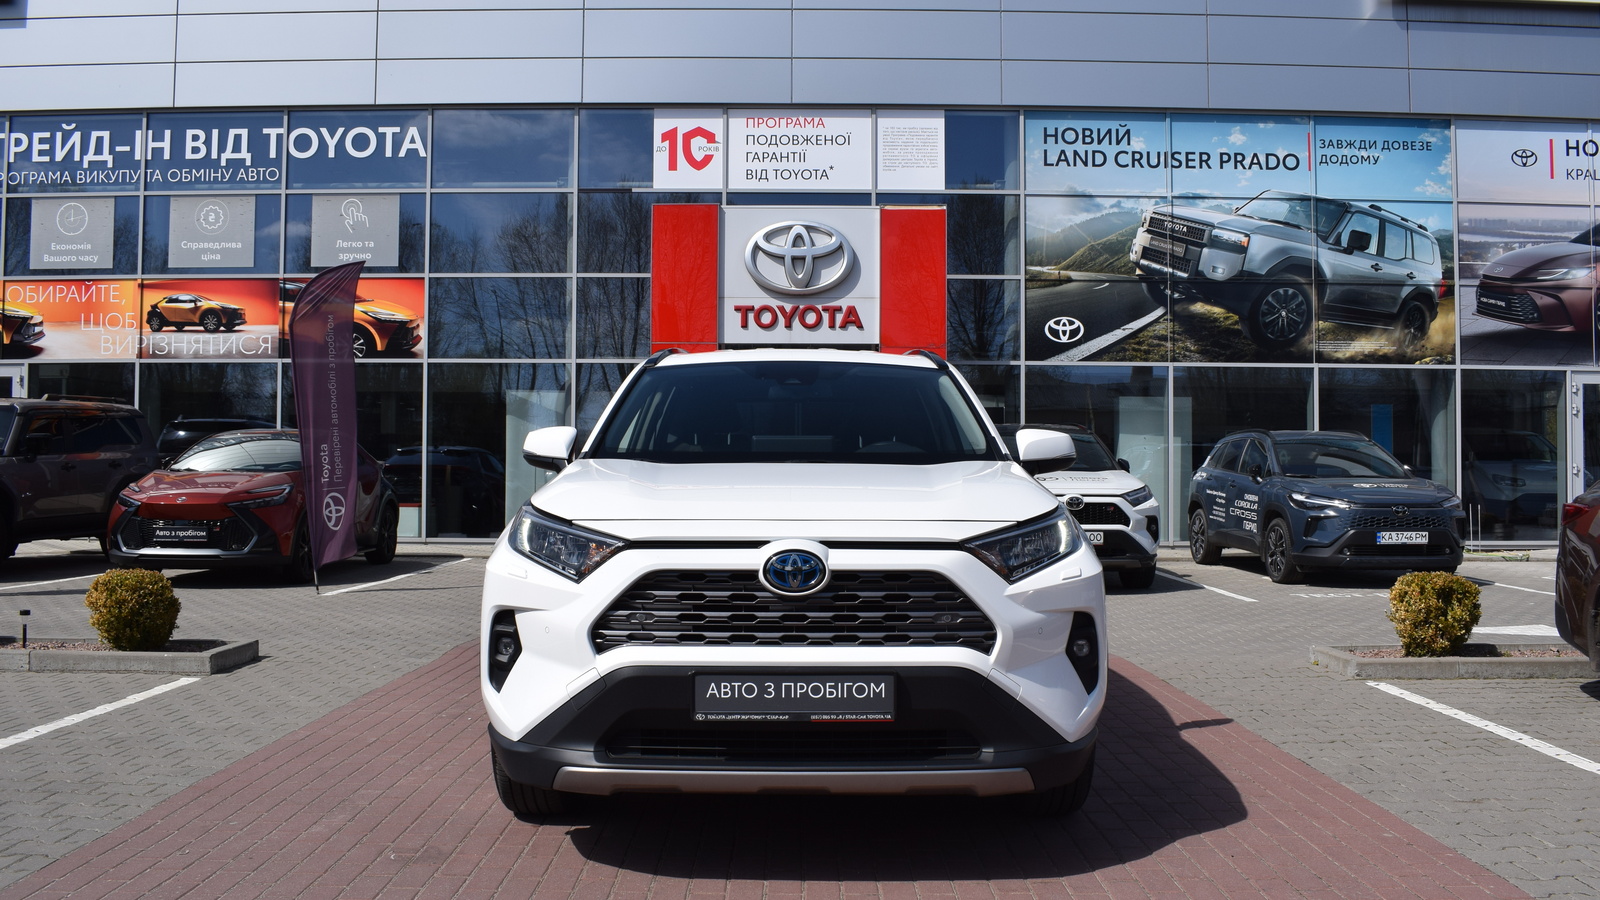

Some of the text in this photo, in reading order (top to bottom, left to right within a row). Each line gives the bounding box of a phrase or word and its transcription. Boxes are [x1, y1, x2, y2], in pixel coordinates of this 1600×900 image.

[745, 117, 826, 128] ПРОГРАМА
[745, 132, 852, 148] ПОДОВЖЕНОЇ
[1043, 123, 1131, 146] НОВИЙ
[185, 128, 252, 166] ВІД
[262, 126, 427, 159] TOYOTA
[1318, 138, 1433, 152] ЗАВЖДИ ДОВЕЗЕ
[745, 149, 808, 163] ГАРАНТІЇ
[1043, 149, 1300, 171] LAND CRUISER PRADO
[1318, 153, 1380, 166] ДОДОМУ
[76, 169, 141, 184] ВИКУПУ
[146, 169, 163, 182] ТА
[167, 168, 233, 182] ОБМІНУ
[236, 167, 280, 181] АВТО
[745, 169, 769, 183] ВІД
[1164, 222, 1187, 233] TOYOTA
[51, 242, 92, 250] Економія
[181, 240, 242, 250] Справедлива
[335, 239, 363, 248] Легко
[43, 254, 99, 263] Вашого часу
[201, 252, 221, 261] ціна
[338, 253, 372, 261] зручно
[6, 281, 126, 305] ОБИРАЙТЕ,
[81, 312, 137, 333] ЩОБ
[733, 304, 864, 329] TOYOTA
[100, 334, 272, 355] ВИРІЗНЯТИСЯ
[325, 314, 337, 361] пробігом
[328, 371, 342, 424] автомобілі
[330, 427, 343, 482] Перевірені
[320, 444, 331, 484] Toyota
[1234, 499, 1258, 510] COROLLA
[1229, 507, 1258, 521] CROSS
[176, 529, 206, 537] пробігом
[1381, 533, 1427, 541] KA 3746 PM
[706, 682, 885, 698] АВТО З ПРОБІГОМ
